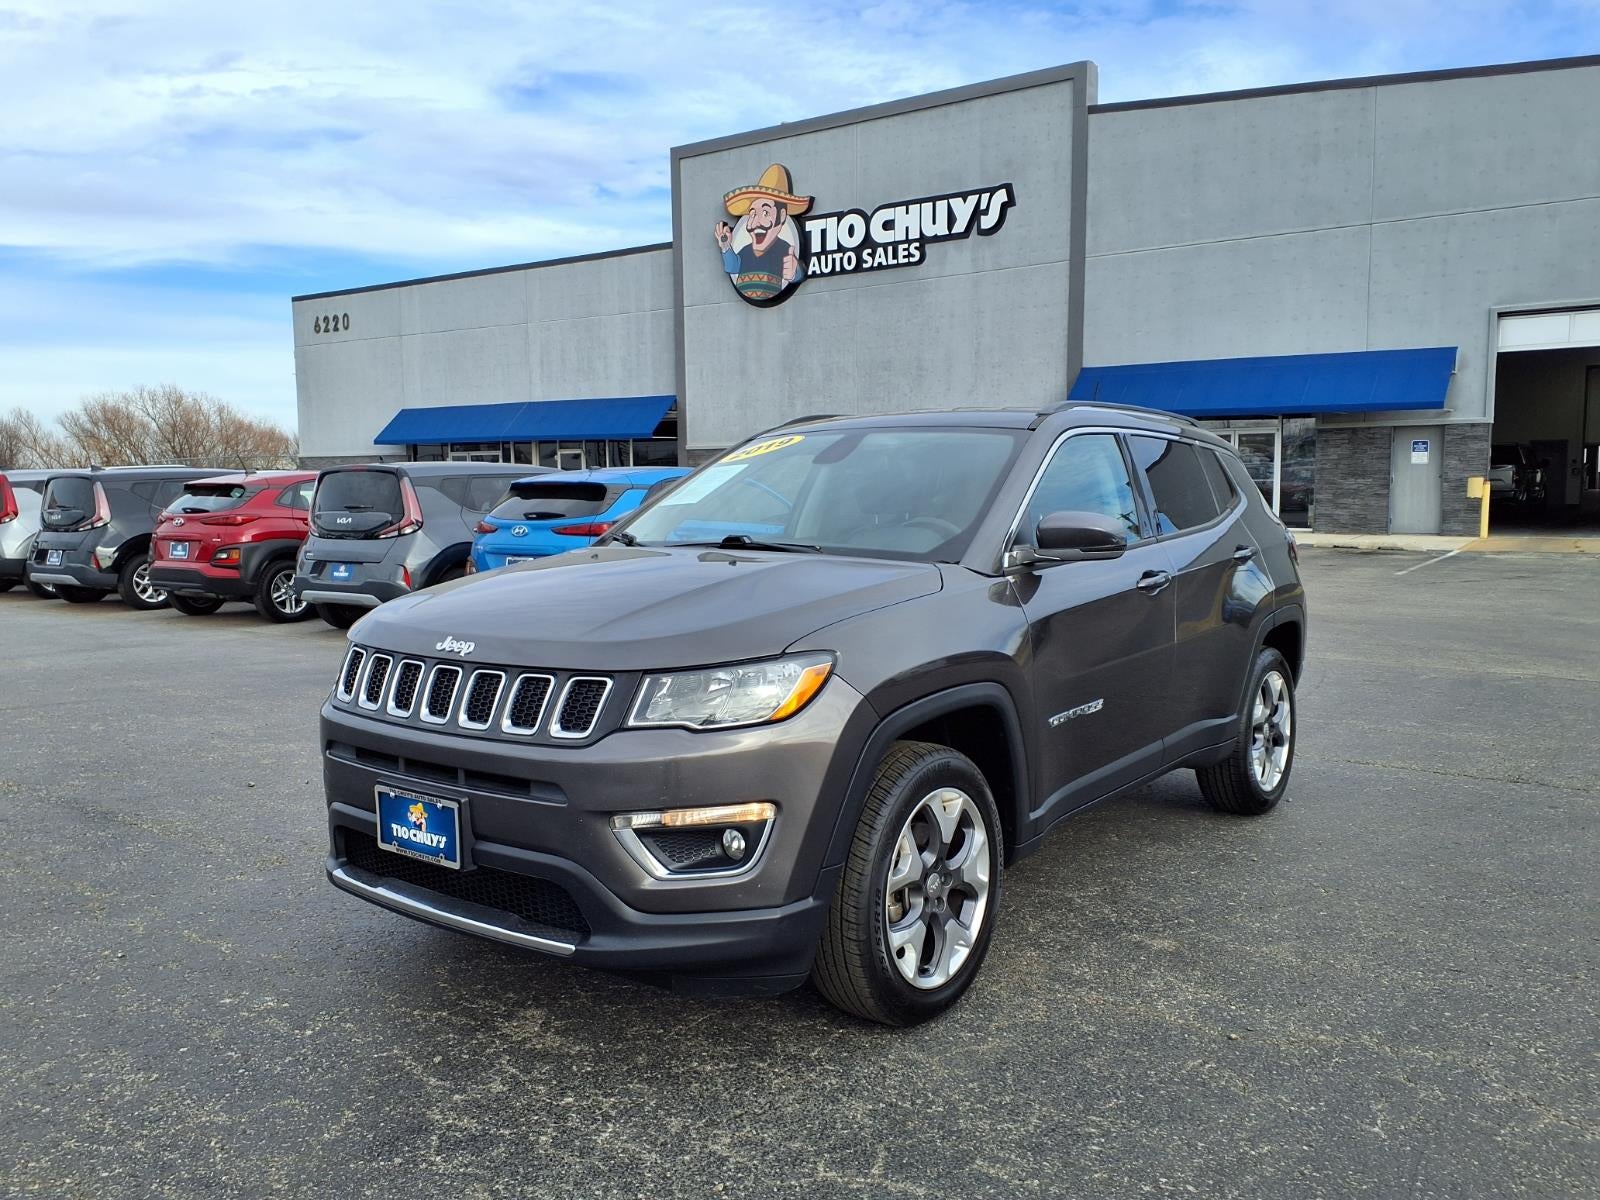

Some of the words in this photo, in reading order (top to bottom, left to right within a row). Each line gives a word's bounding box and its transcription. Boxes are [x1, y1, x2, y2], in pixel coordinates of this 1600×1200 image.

[805, 213, 866, 254] TIO
[869, 188, 1008, 244] CHUY'S
[807, 252, 857, 275] AUTO
[862, 242, 921, 269] SALES
[313, 312, 350, 334] 6220
[435, 635, 476, 657] Jeep
